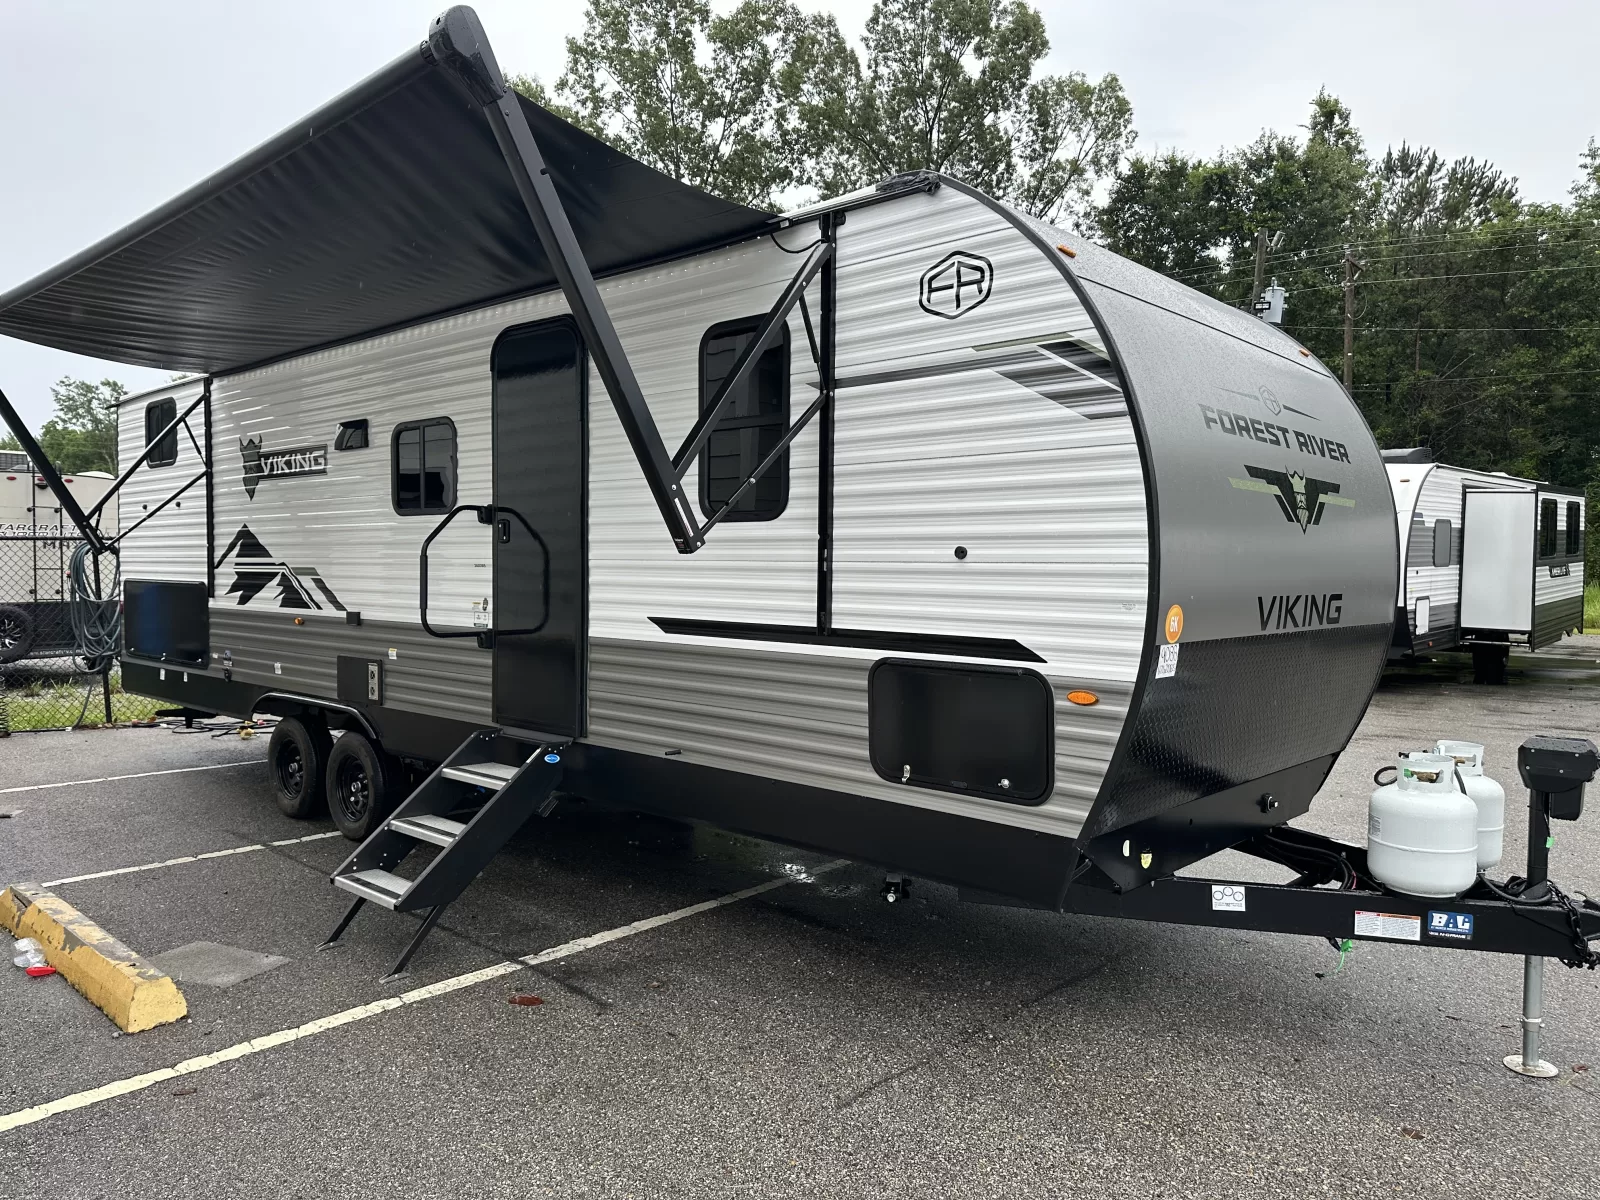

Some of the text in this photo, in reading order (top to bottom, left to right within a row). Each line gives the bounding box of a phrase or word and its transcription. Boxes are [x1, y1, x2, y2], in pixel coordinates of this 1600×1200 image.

[1198, 403, 1351, 464] FOREST RIVER
[261, 450, 325, 475] VIKING
[1257, 593, 1343, 631] VIKING
